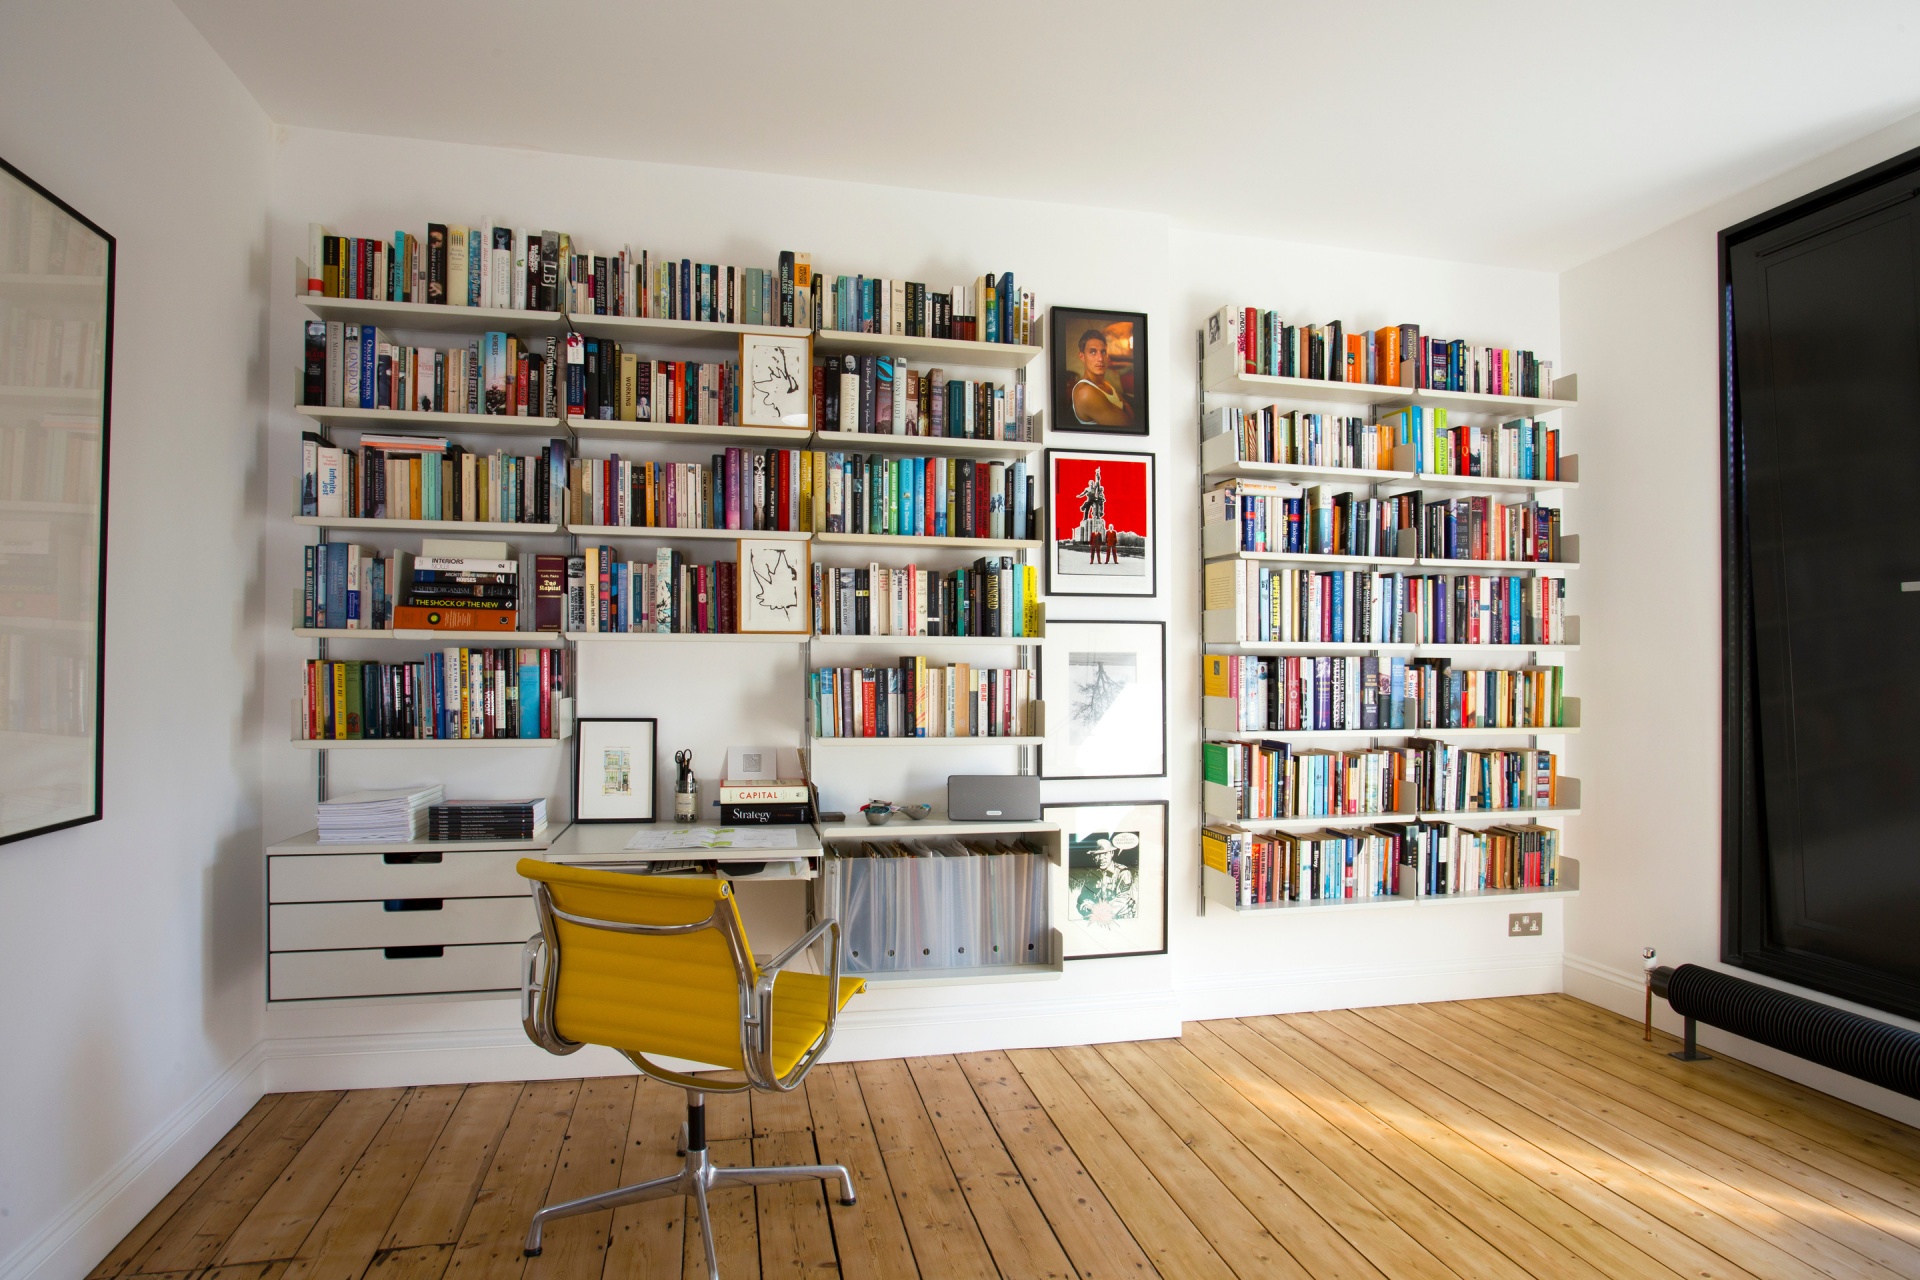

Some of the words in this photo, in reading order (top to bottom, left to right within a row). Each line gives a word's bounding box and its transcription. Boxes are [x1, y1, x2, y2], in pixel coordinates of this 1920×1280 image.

[541, 263, 556, 289] LBJ
[988, 575, 998, 609] STALINGRAD
[733, 808, 771, 822] Strategy
